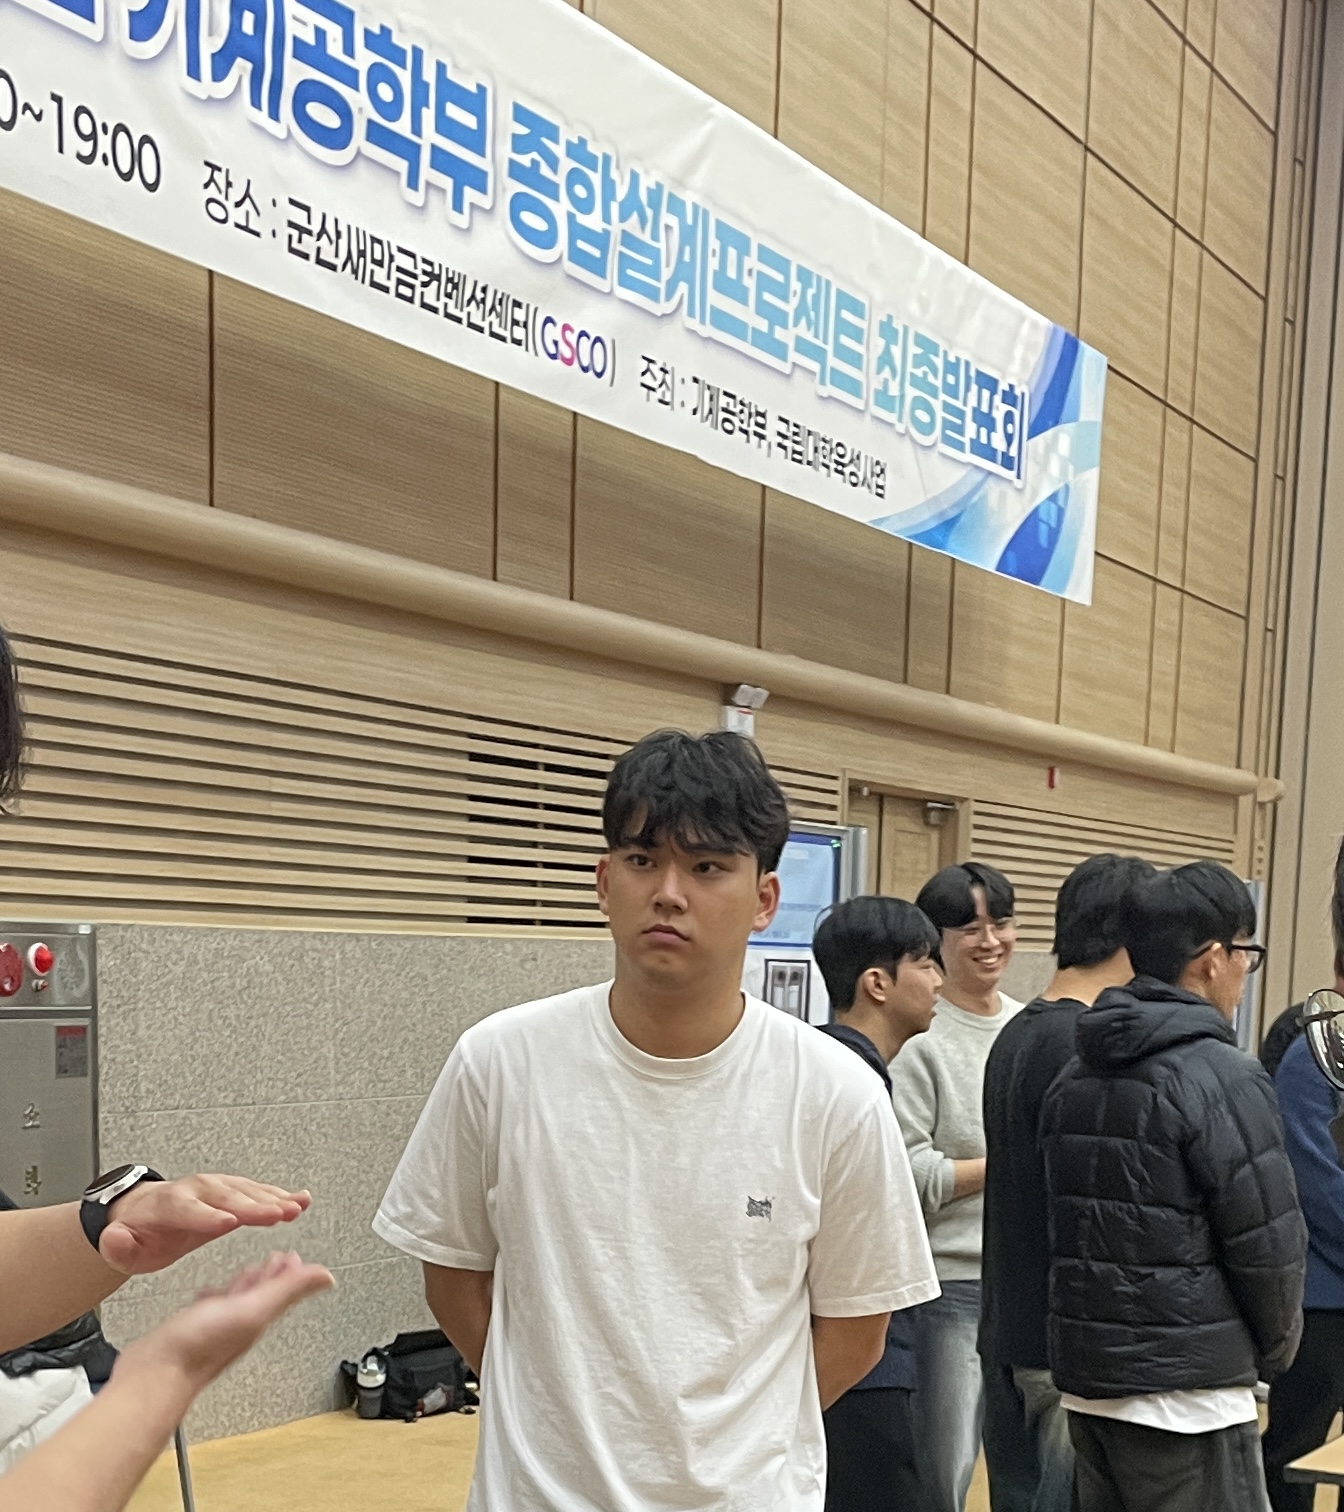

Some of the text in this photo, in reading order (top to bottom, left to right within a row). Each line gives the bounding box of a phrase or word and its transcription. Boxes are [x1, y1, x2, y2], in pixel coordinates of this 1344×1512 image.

[203, 159, 261, 238] 장소
[287, 197, 616, 388] 군산새만금컨벤션센터(GSCO)
[640, 354, 675, 411] 주최
[776, 415, 887, 499] 국립대학육성사업
[507, 100, 867, 404] 종합설계프로젝트
[873, 315, 1029, 474] 최종발표회
